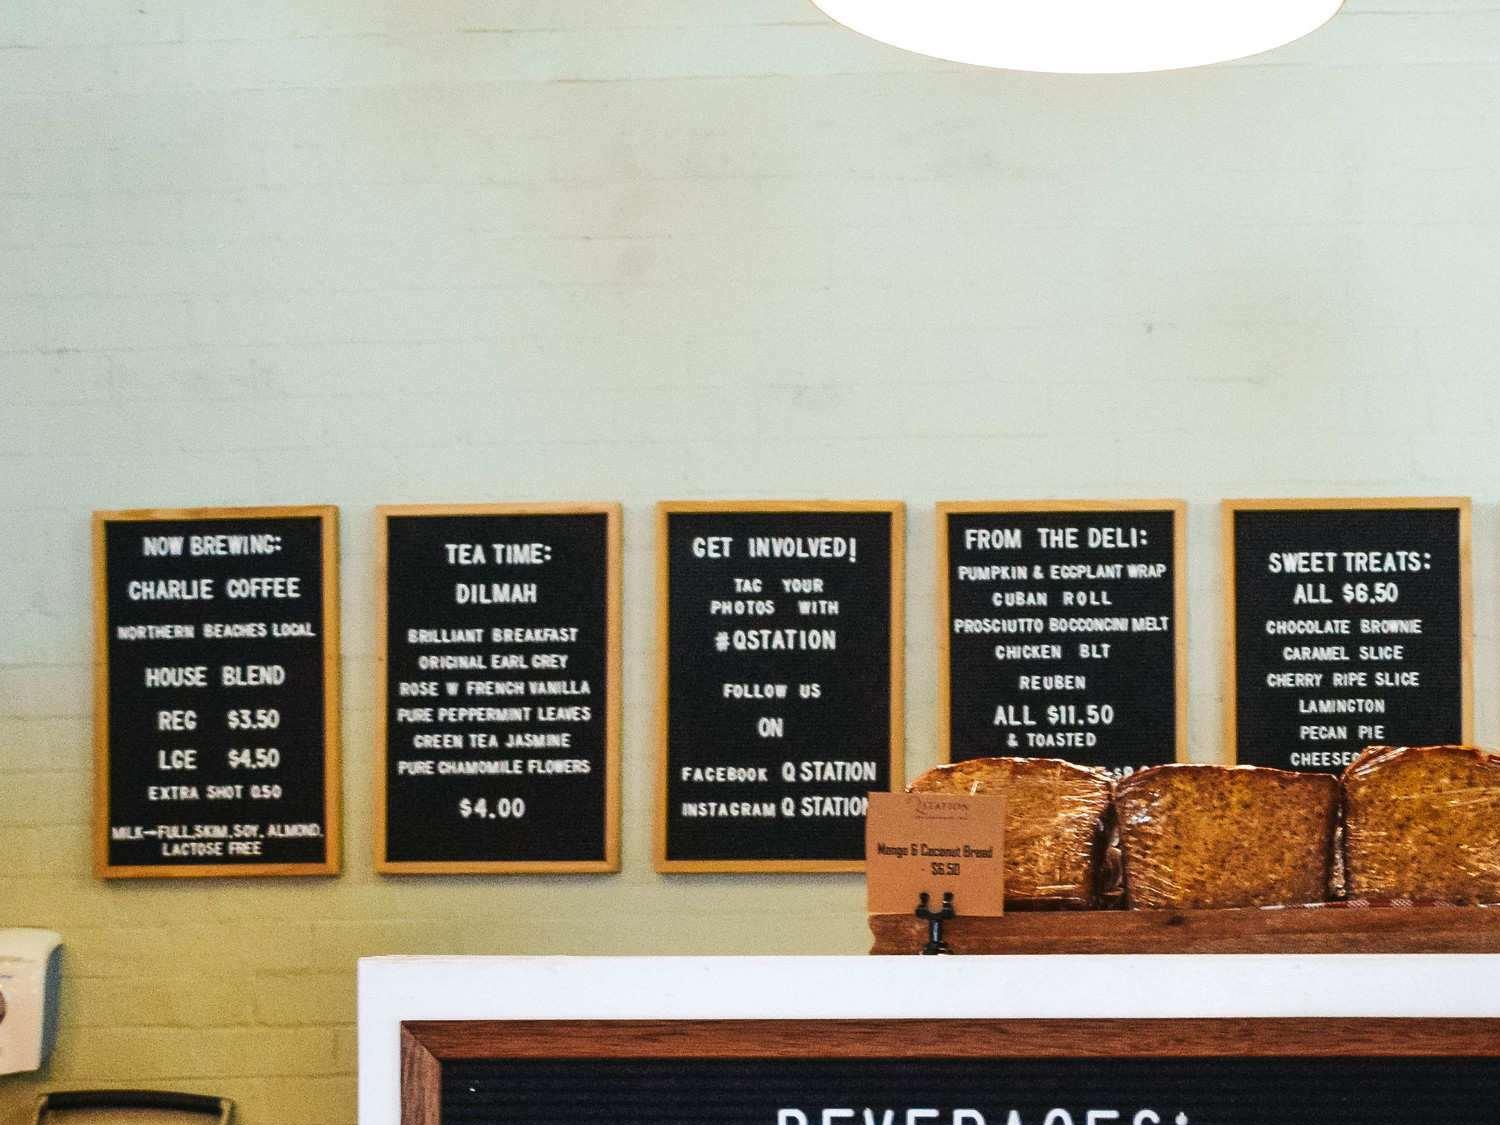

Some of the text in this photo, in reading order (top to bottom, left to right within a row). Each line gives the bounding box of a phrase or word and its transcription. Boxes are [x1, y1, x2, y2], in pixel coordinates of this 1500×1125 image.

[144, 534, 281, 556] NOW BREWING:
[965, 528, 1147, 549] FROM THE DELI:
[445, 543, 551, 565] TEA TIME:
[692, 537, 856, 563] GET INVOLVED!
[1269, 551, 1431, 573] SWEET TREATS:
[958, 564, 1166, 581] PUMPKIN & EGGPLANT WRAP
[129, 577, 301, 600] CHARLIE COFFEE
[456, 583, 536, 604] DILMAH
[734, 578, 823, 593] TAG YOUR
[1293, 582, 1398, 604] ALL $6.50
[992, 591, 1112, 606] CUBAN ROLL
[710, 600, 839, 615] PHOTOS WITH
[118, 623, 316, 640] NORTHERN BEACHES LOCAL
[954, 616, 1169, 633] PROSCIUTTO BOCCONCINI MELT
[1266, 619, 1422, 634] CHOCOLATE BROWNIE
[408, 628, 578, 643] BRILLIANT BREAKFAST
[715, 629, 836, 651] #QSTATION
[995, 643, 1110, 660] CHICKEN BLT
[1283, 645, 1403, 661] CARAMEL SLICE
[419, 654, 568, 670] ORIGINAL EARL GREY
[146, 665, 285, 687] HOUSE BLEND
[1019, 675, 1085, 690] REUBEN
[1267, 672, 1419, 687] CHERRY RIPE SLICE
[400, 680, 590, 696] ROSE W FRENCH VANILLA
[723, 683, 821, 698] FOLLOW US
[397, 706, 591, 722] PURE PEPPERMINT LEAVES
[1299, 699, 1385, 713] LAMINGTON
[158, 709, 280, 730] REG $3.50
[994, 705, 1114, 726] ALL $11.50
[758, 717, 783, 737] ON
[1300, 725, 1384, 739] PECAN PIE
[414, 733, 571, 748] GREEN TEA JASMINE
[1007, 732, 1096, 747] & TOASTED
[159, 748, 279, 770] LGE $4.50
[398, 759, 591, 775] PURE CHAMOMILE FLOWERS
[682, 761, 876, 782] FACEBOOK Q STATION
[149, 786, 199, 800] EXTRA
[207, 785, 243, 799] SHOT
[460, 798, 525, 818] $4.00
[682, 802, 776, 817] INSTAGRAM
[782, 797, 795, 816] Q
[163, 841, 261, 856] LACTOSE FREE
[878, 843, 908, 858] Mango
[921, 844, 961, 857] Coconut
[963, 845, 993, 858] Bread
